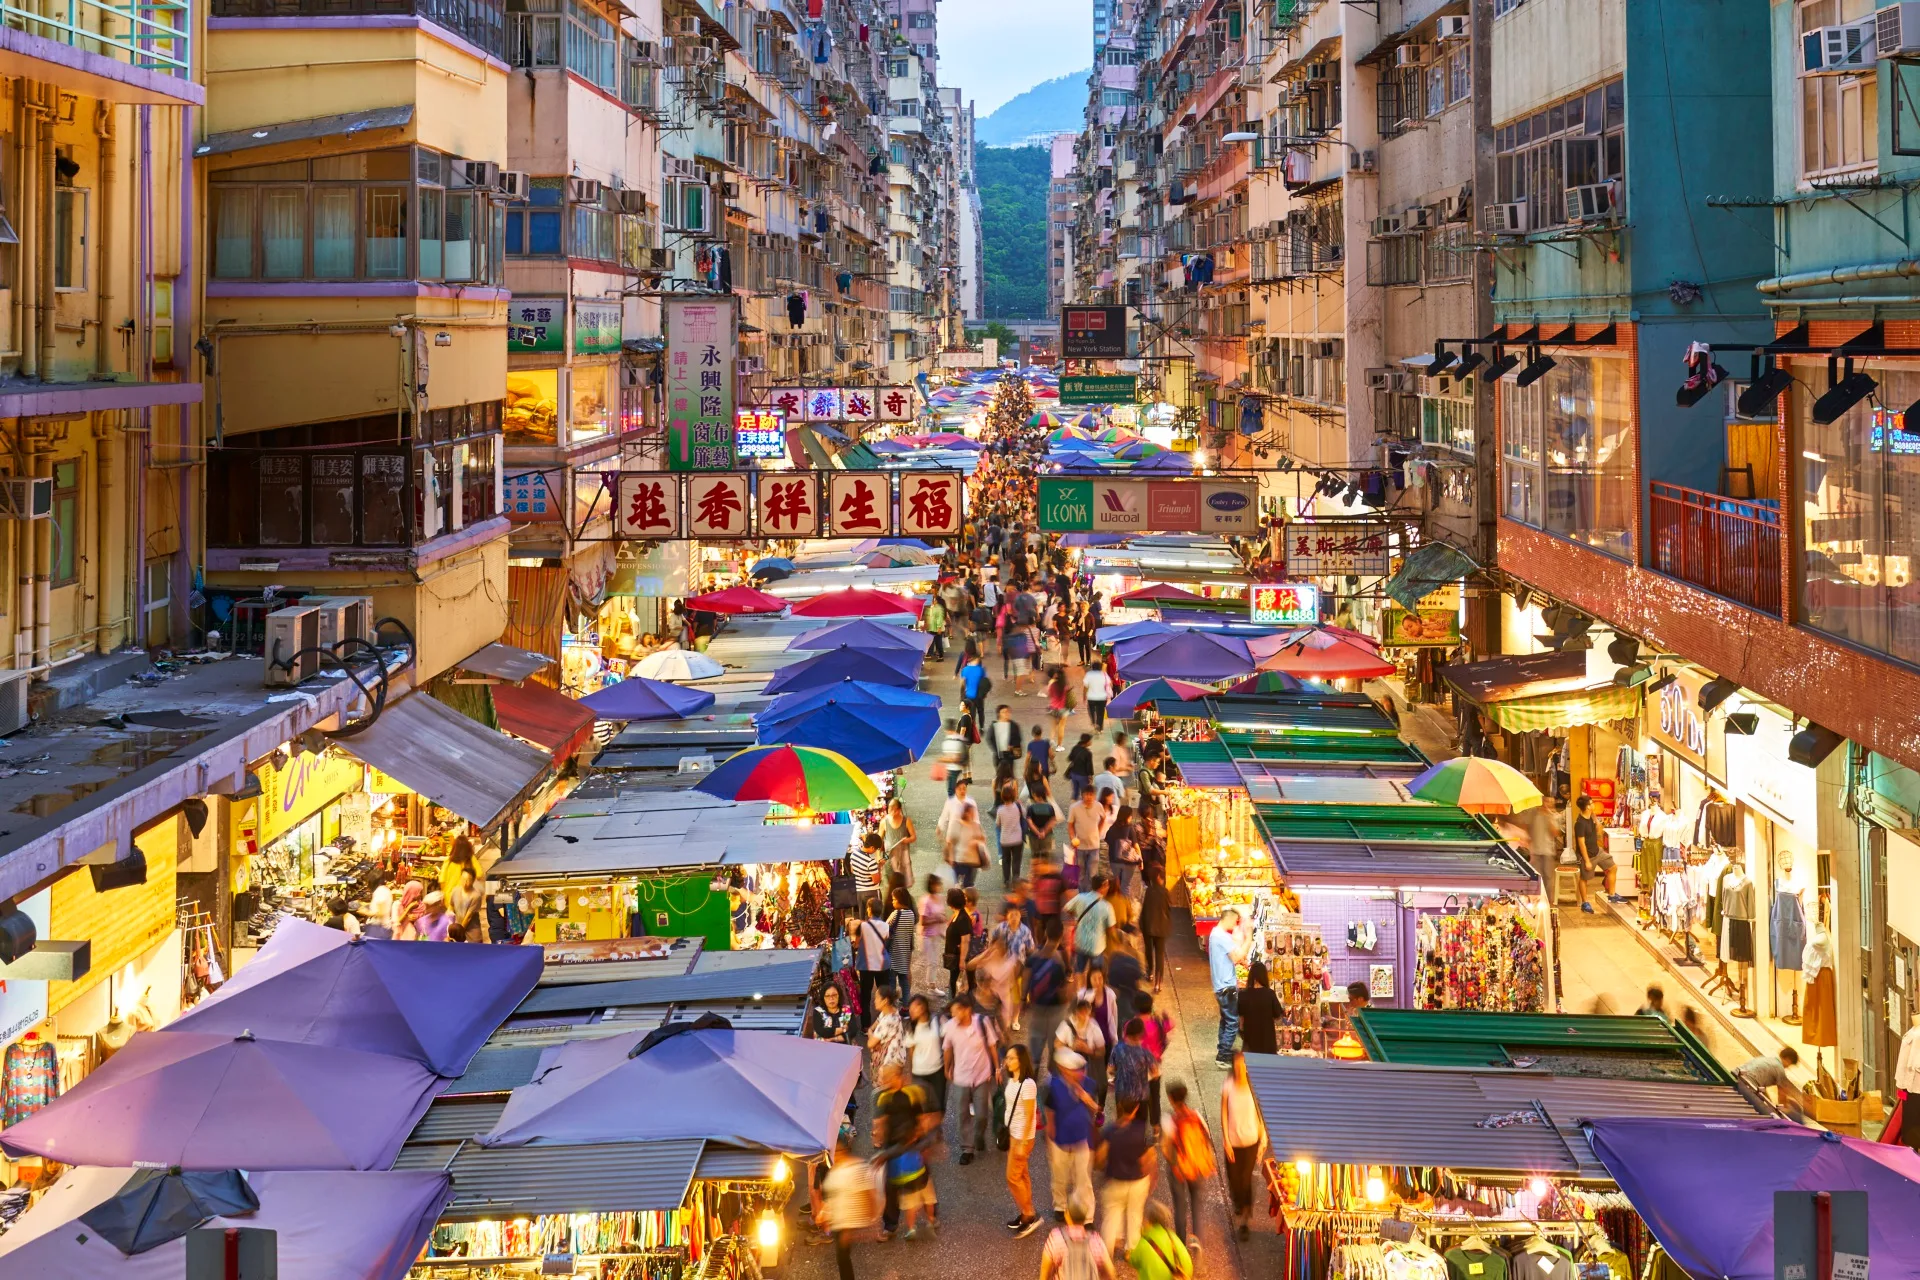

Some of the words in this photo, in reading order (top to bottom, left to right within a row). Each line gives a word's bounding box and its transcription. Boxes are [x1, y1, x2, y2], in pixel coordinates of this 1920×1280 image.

[674, 352, 687, 412] 請上一樓
[700, 345, 722, 417] 永興隆
[313, 459, 353, 476] 雅美姿
[1158, 503, 1192, 514] Triumph
[1101, 513, 1140, 522] Wacoal
